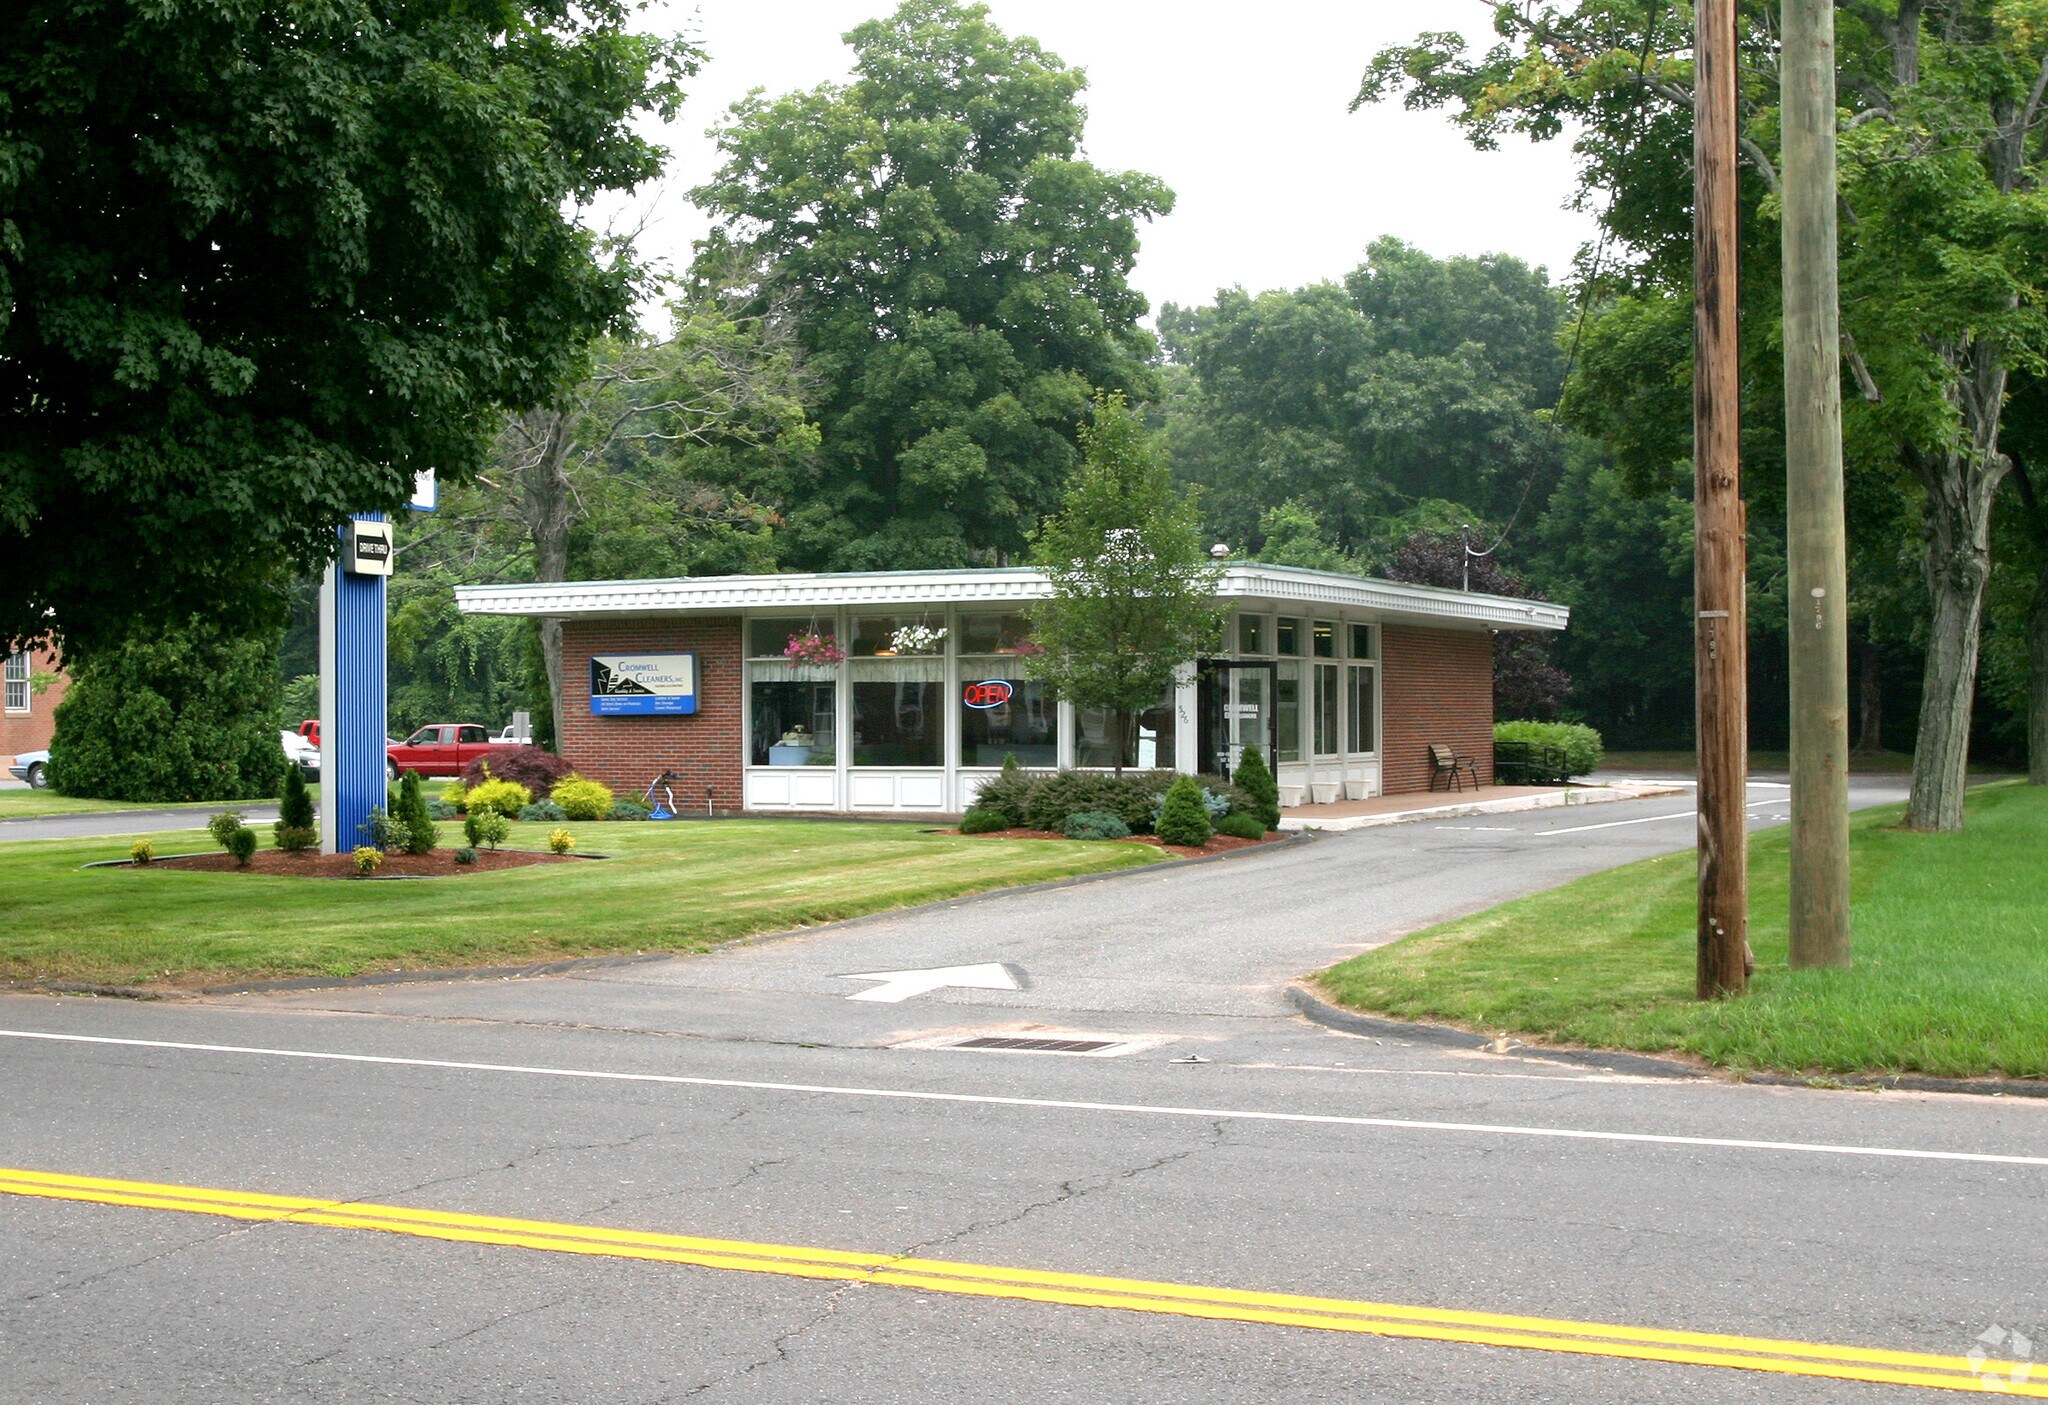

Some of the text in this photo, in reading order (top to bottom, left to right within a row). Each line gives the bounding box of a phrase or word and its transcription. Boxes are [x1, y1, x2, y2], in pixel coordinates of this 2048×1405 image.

[359, 542, 388, 555] DRIVE THRU
[618, 661, 659, 672] CROMWELL
[965, 685, 1009, 704] OPEN
[1178, 705, 1189, 724] 526
